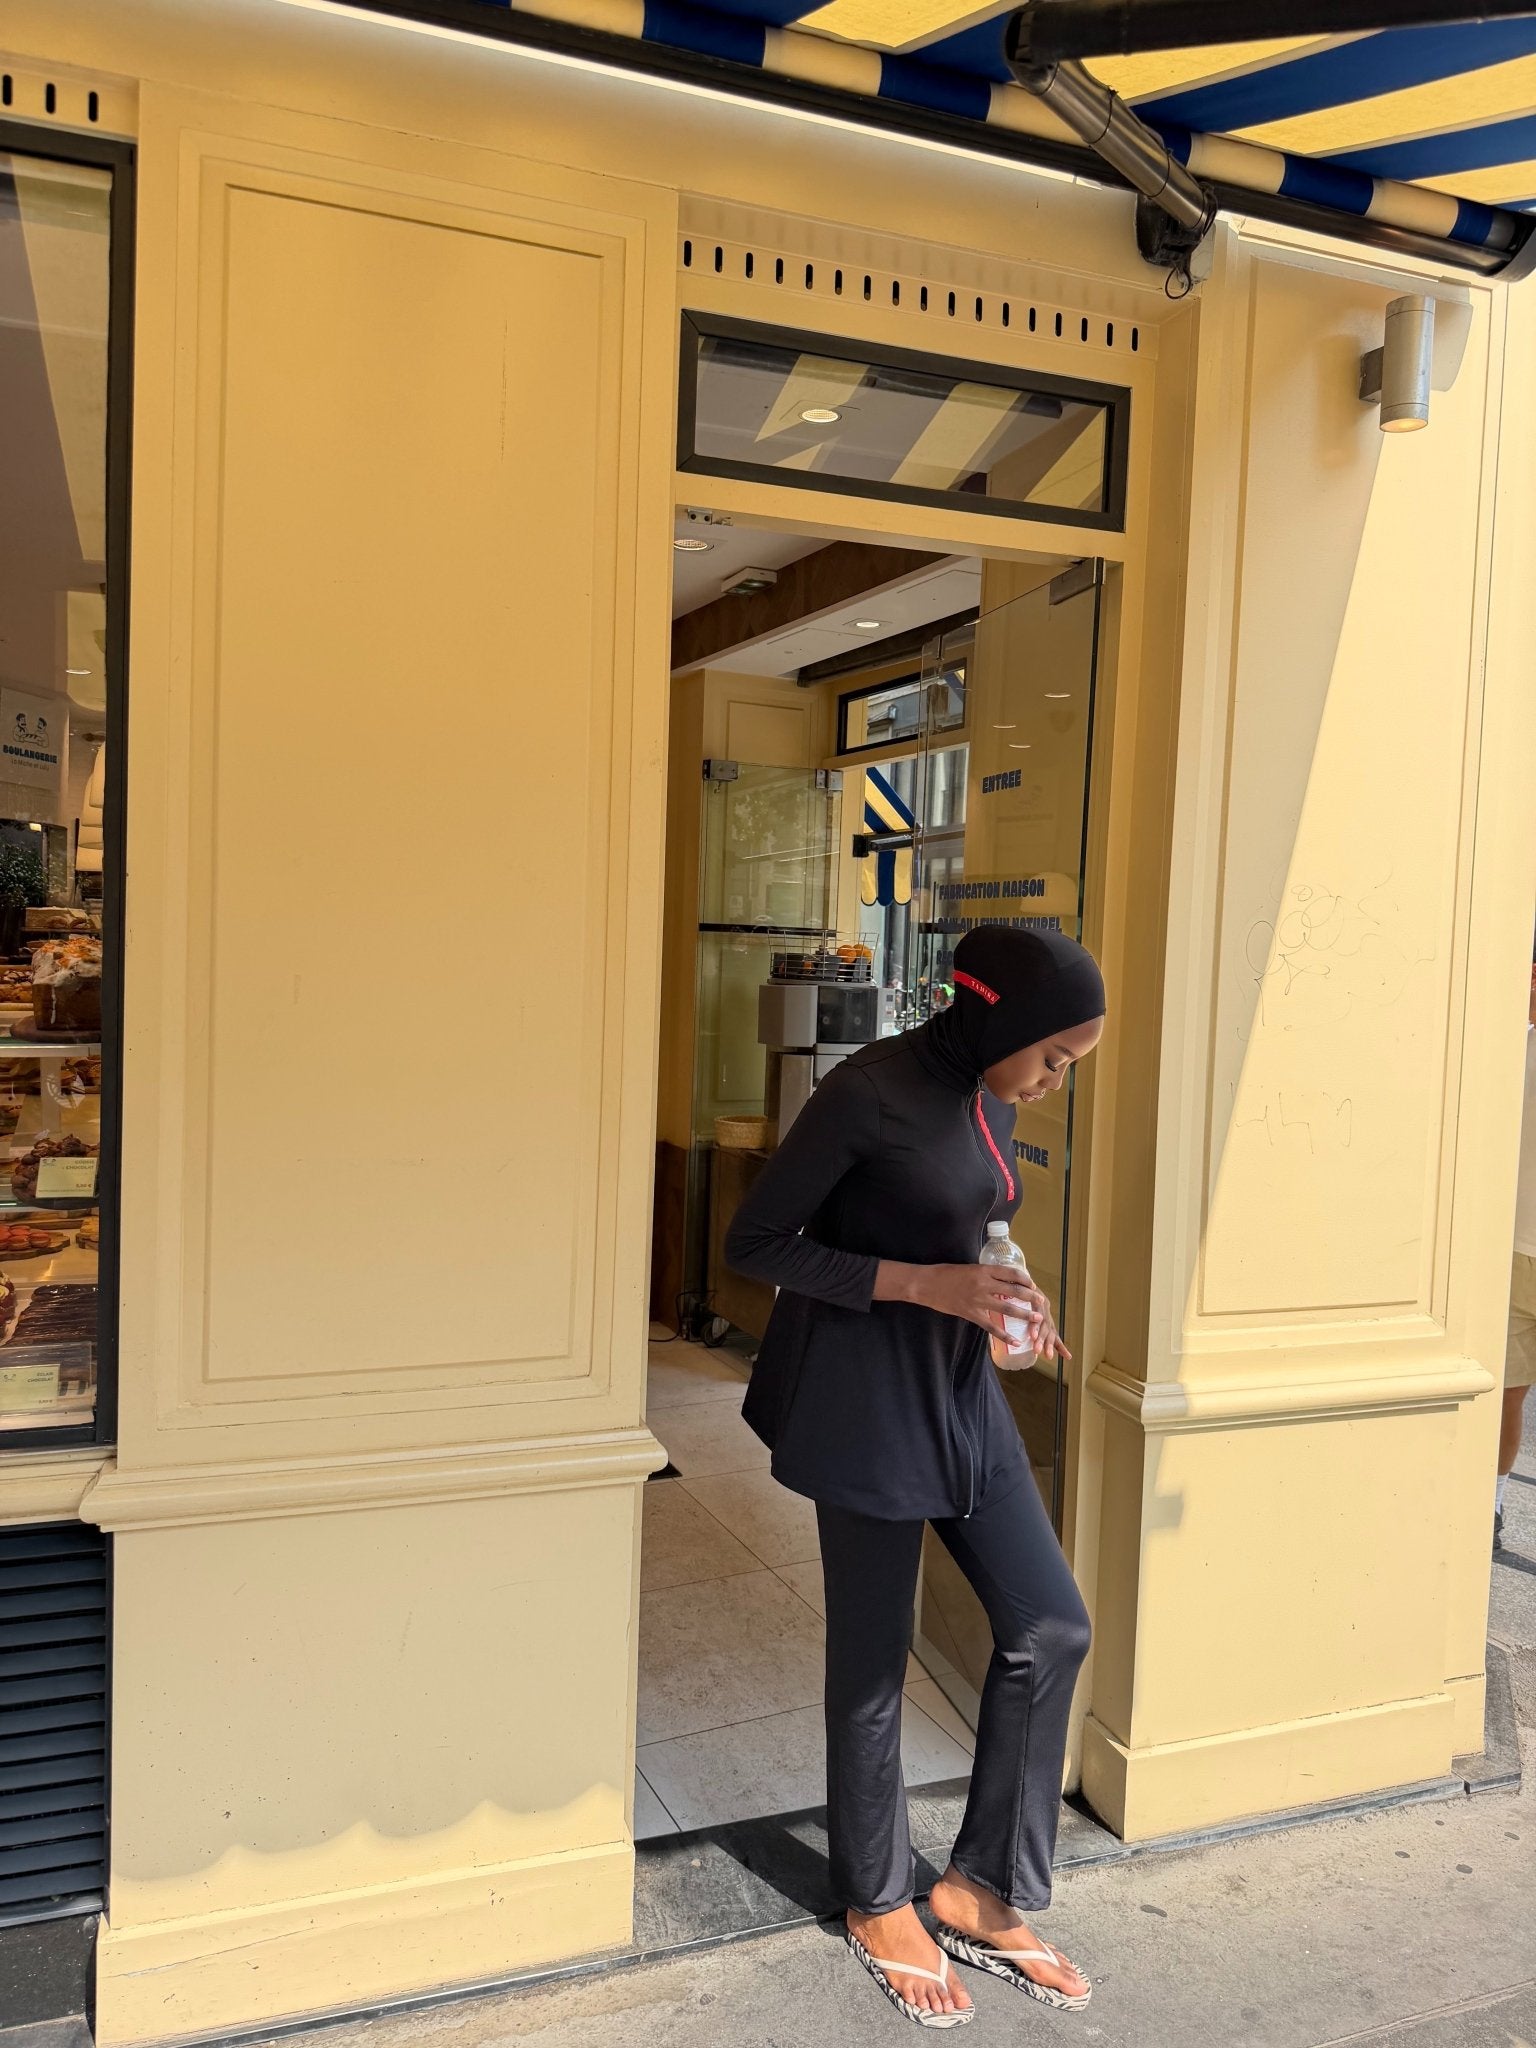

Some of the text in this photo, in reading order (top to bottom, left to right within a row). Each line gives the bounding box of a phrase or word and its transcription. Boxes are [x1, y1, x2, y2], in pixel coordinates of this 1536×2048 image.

[3, 745, 57, 764] BOULANGERIE
[982, 769, 1022, 793] ENTREE
[939, 879, 1045, 900] FABRICATION MAISON
[1012, 1139, 1049, 1168] RTURE
